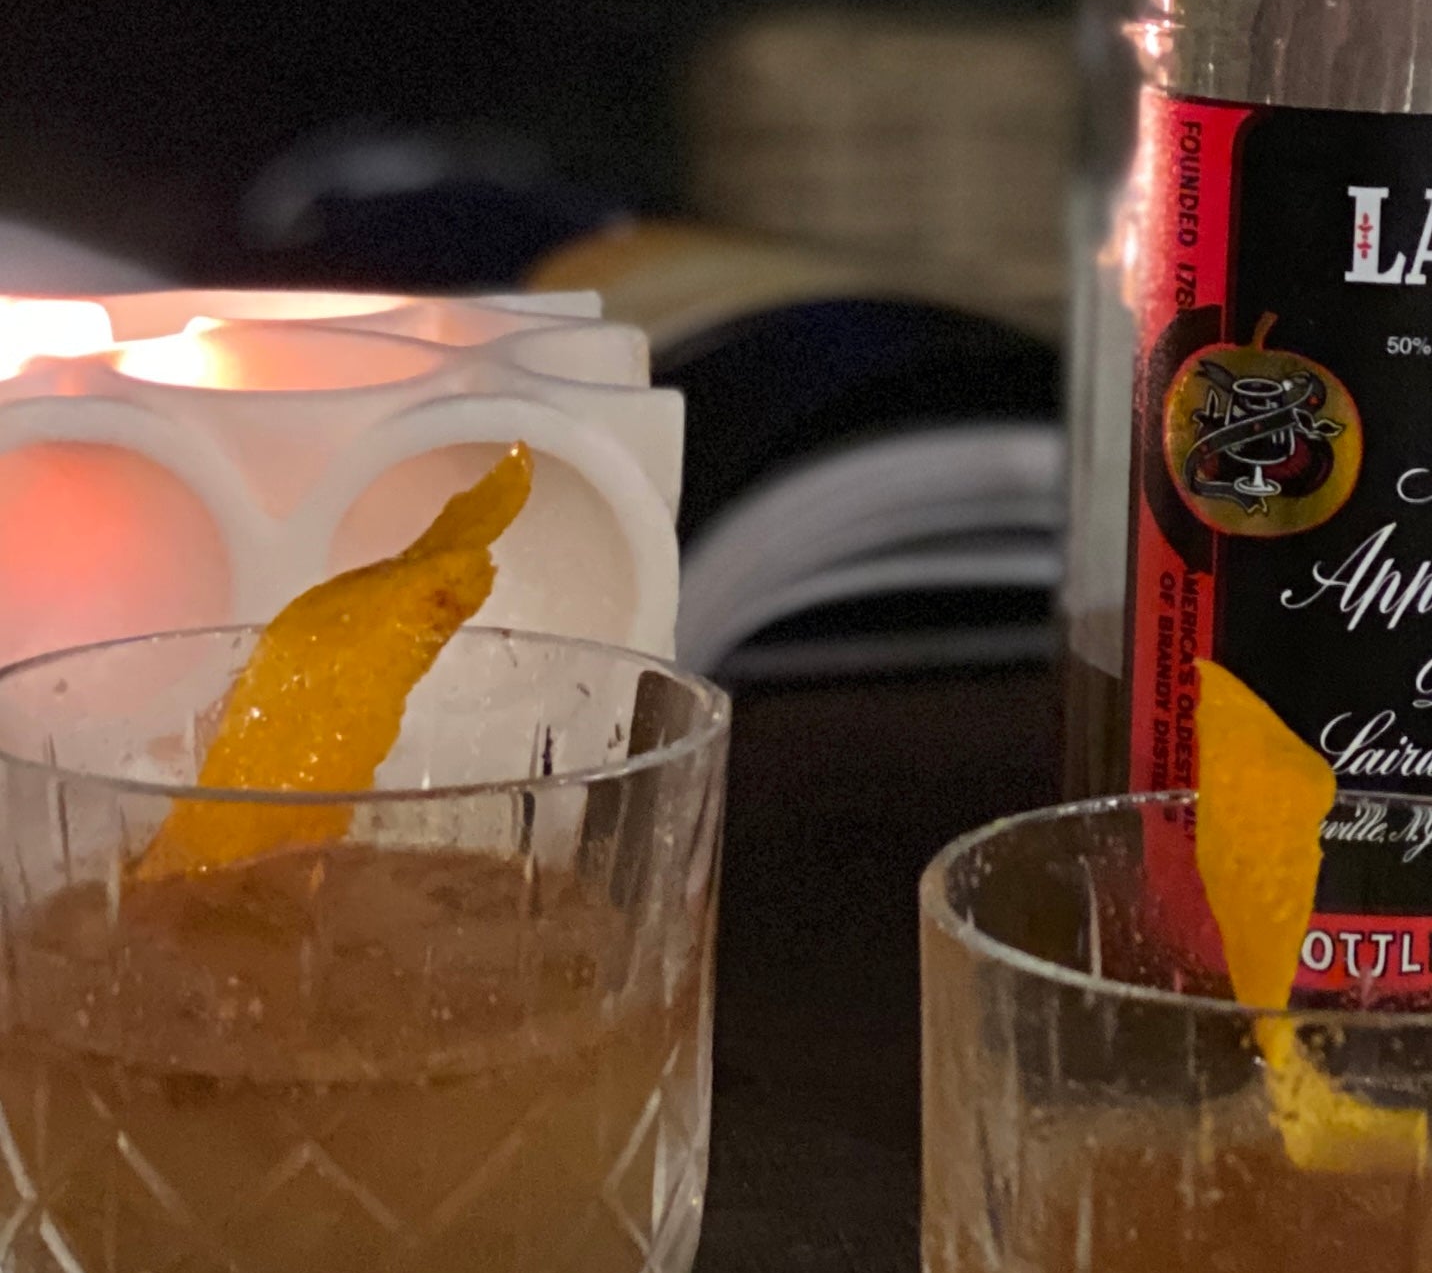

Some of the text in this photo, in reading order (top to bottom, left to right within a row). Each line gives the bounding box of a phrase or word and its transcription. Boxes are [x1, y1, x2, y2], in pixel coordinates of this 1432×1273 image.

[1175, 121, 1202, 315] FOUNDED 178
[1387, 336, 1432, 356] 50%
[1160, 571, 1177, 609] OF
[1155, 614, 1175, 713] BRANDY
